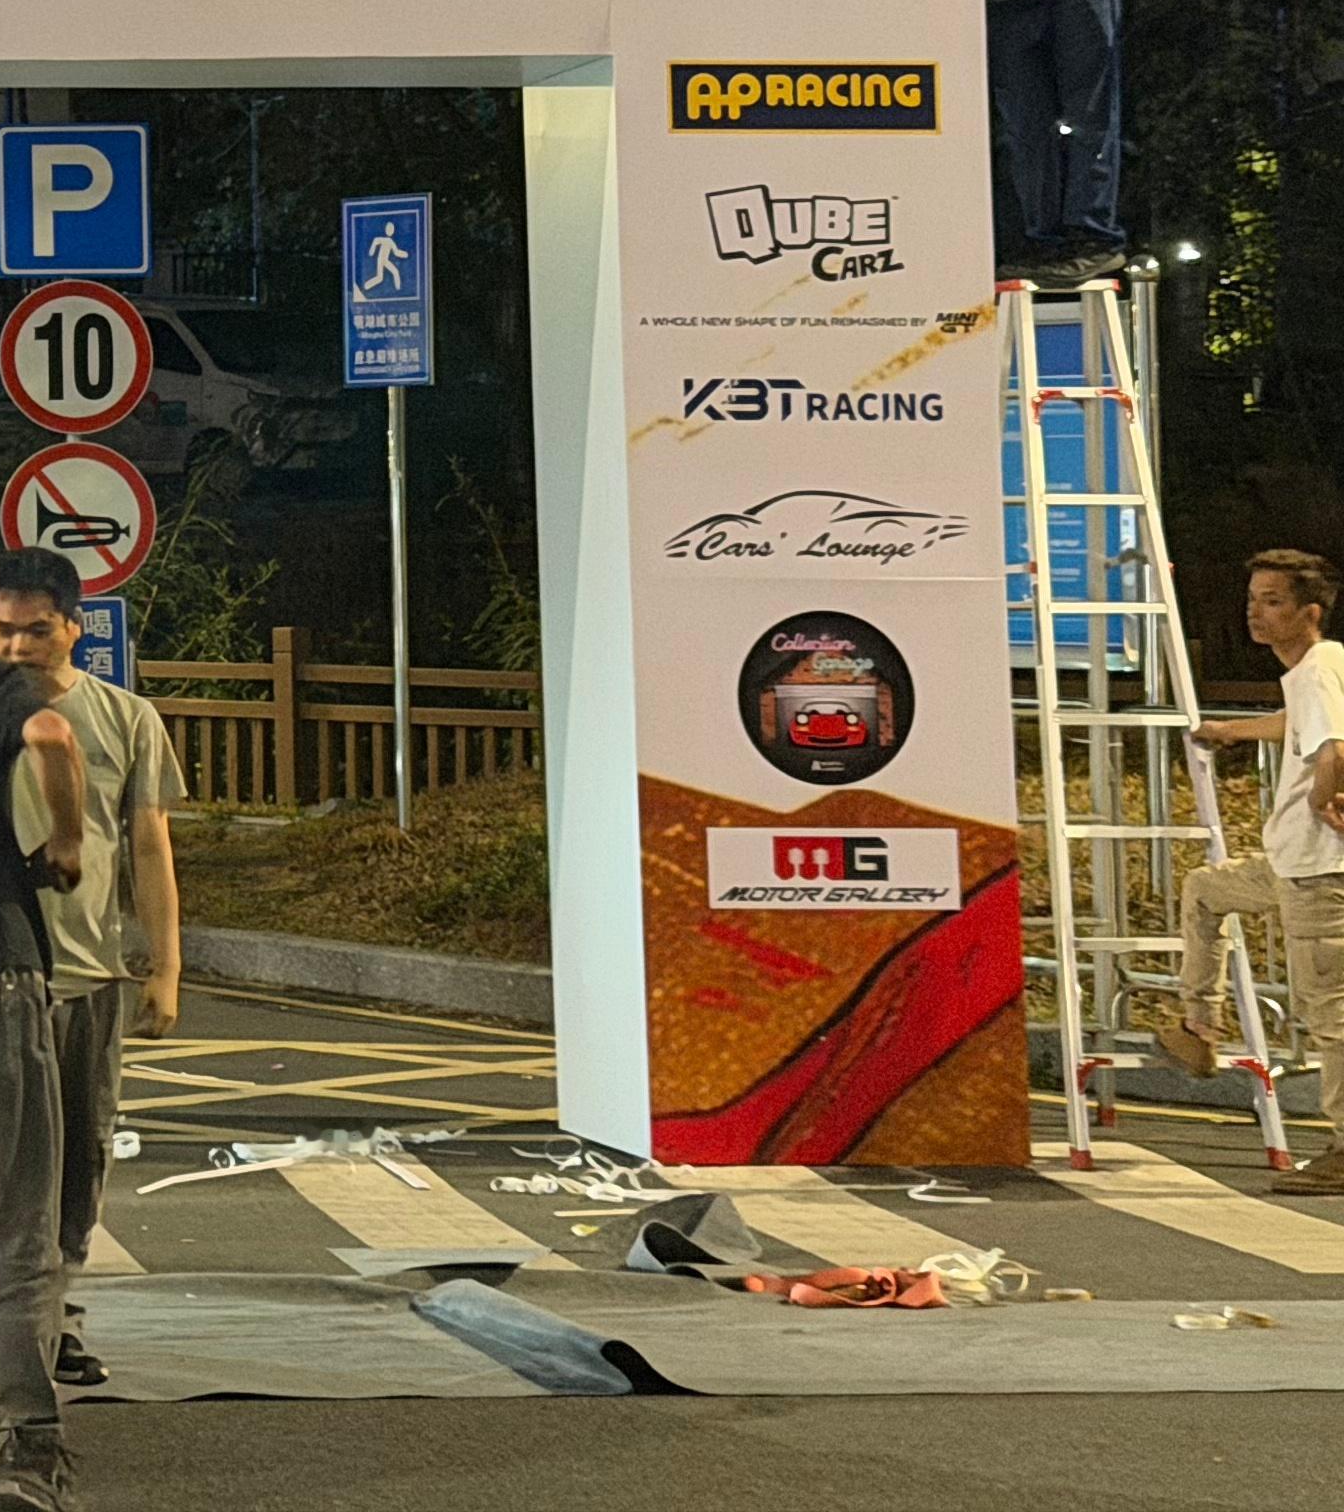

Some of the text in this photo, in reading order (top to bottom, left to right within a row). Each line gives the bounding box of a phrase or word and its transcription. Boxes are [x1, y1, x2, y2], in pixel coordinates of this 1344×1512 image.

[765, 73, 921, 107] RACING
[32, 144, 113, 256] P
[705, 185, 890, 264] QUBE
[812, 247, 904, 281] CARZ
[701, 317, 732, 326] NEW
[35, 312, 114, 402] 10
[807, 393, 944, 421] RACING
[796, 533, 915, 565] Lounge
[718, 887, 819, 902] MOTOR
